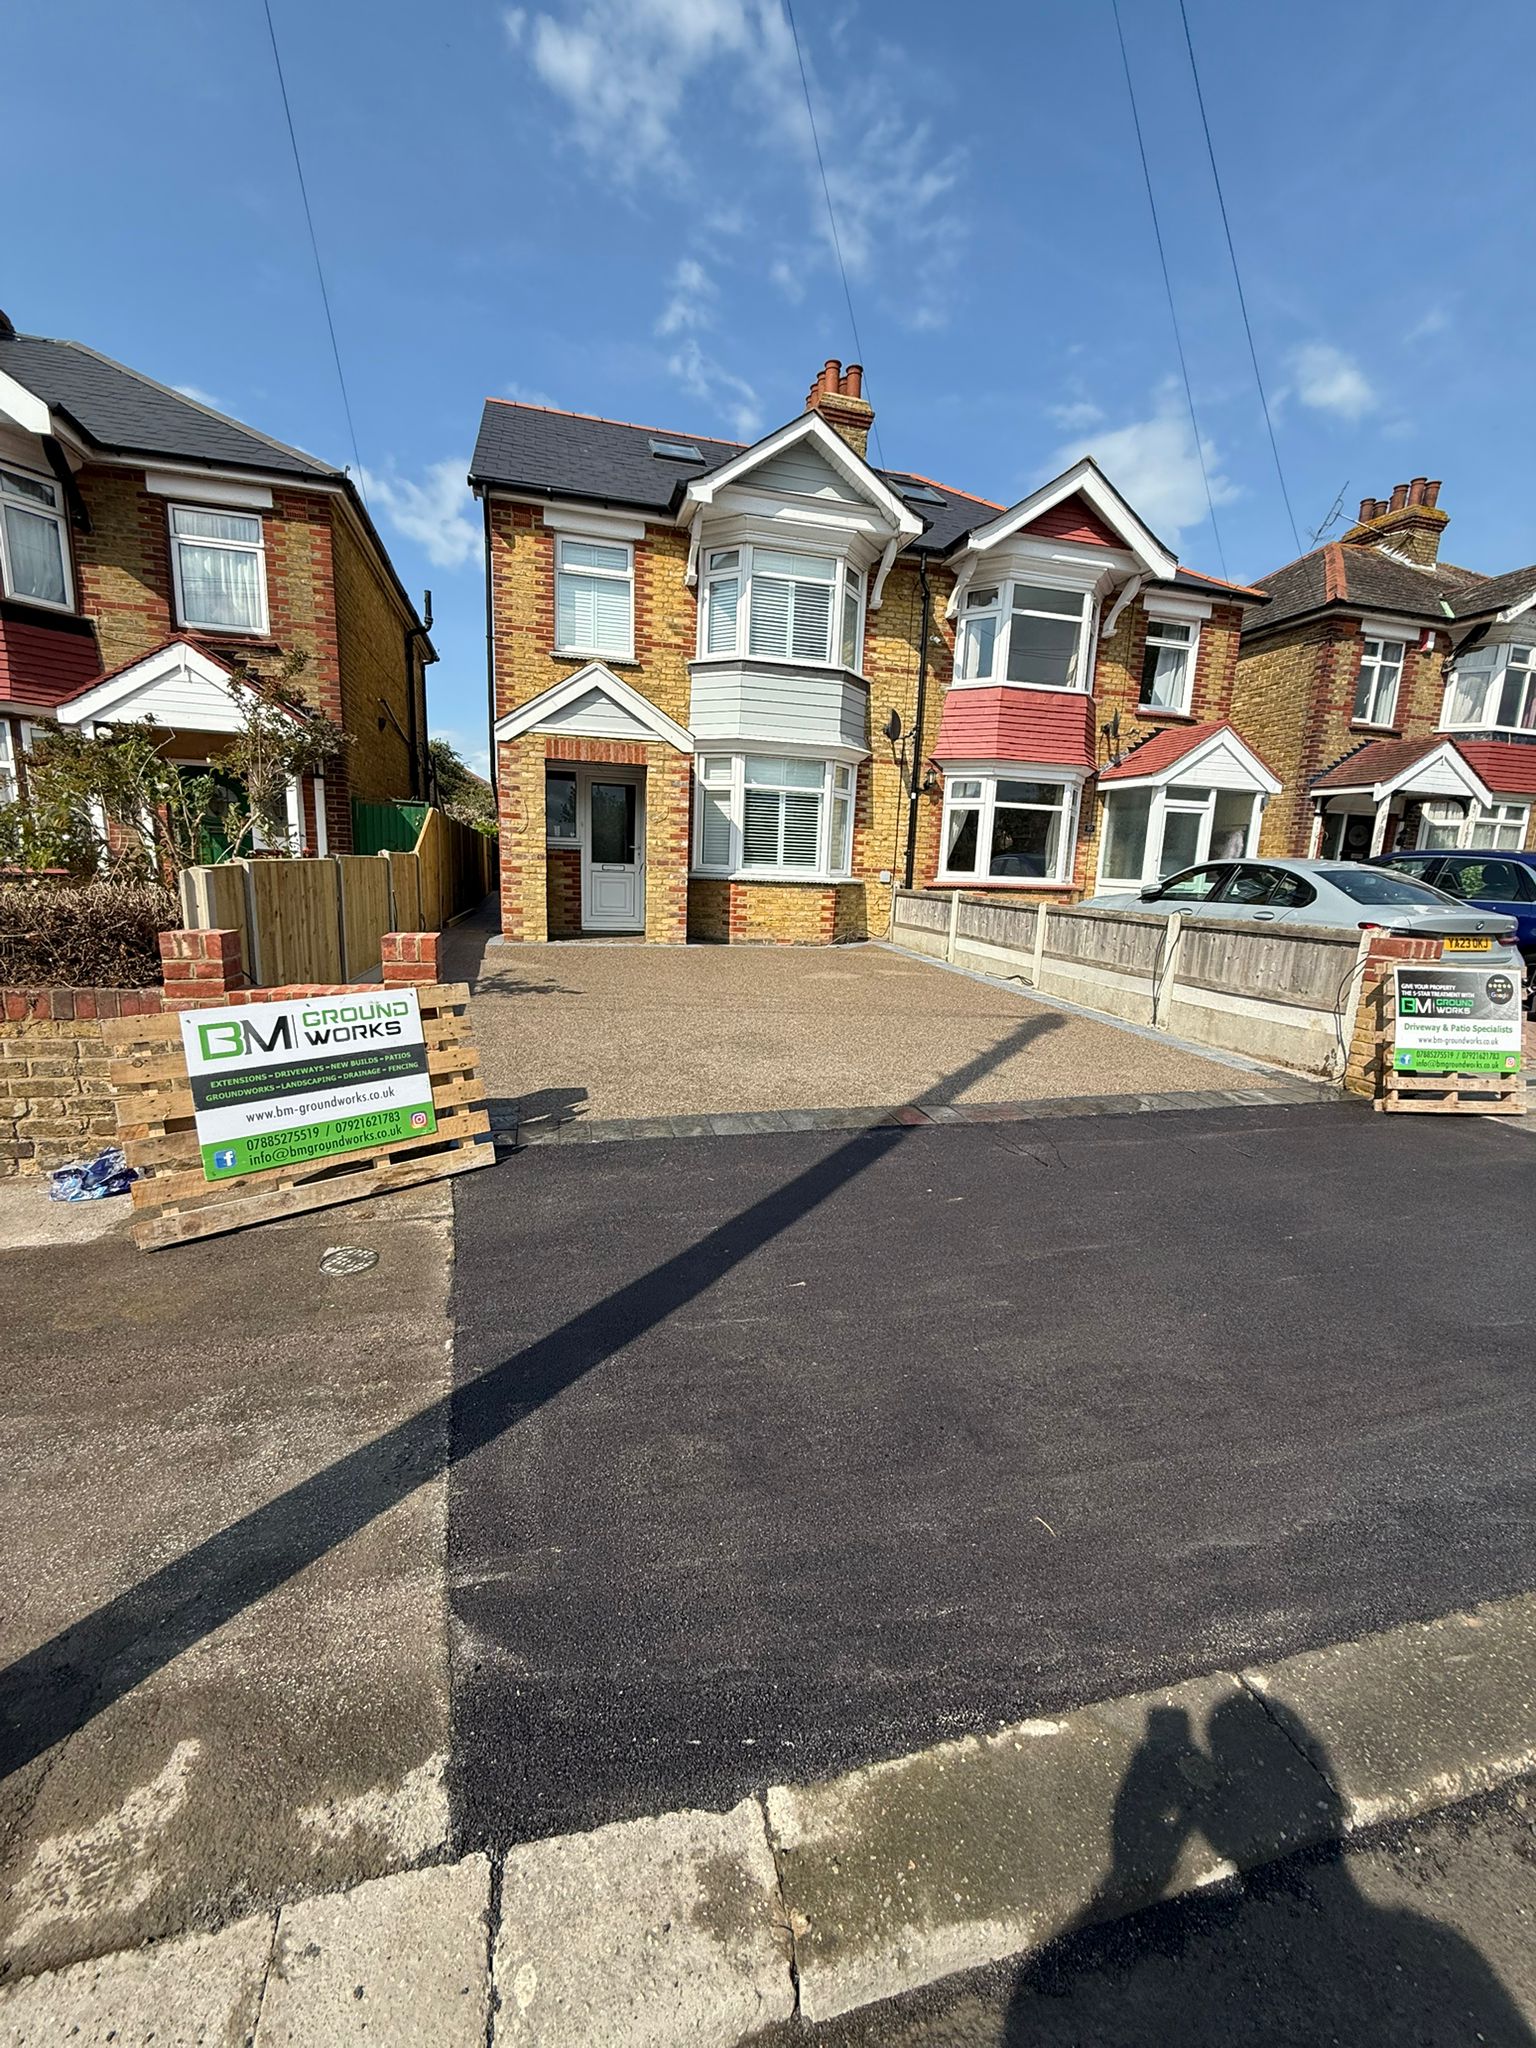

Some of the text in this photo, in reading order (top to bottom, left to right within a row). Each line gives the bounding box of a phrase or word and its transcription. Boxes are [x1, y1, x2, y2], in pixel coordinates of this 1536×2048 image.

[1448, 937, 1471, 948] YA23
[302, 1001, 409, 1027] GROUND
[1401, 998, 1432, 1014] BM
[1436, 998, 1474, 1007] GROUND
[1436, 1006, 1471, 1014] WORKS
[197, 1015, 293, 1061] BM
[304, 1020, 402, 1046] WORKS
[1404, 1023, 1440, 1032] Driveway
[1450, 1024, 1471, 1032] Patio
[1472, 1025, 1513, 1033] Specialists
[1418, 1036, 1499, 1045] www.bm-groundworks.co.uk
[205, 1084, 275, 1102] GROUNDWORKS
[281, 1074, 337, 1090] LANDSCAPING
[342, 1067, 381, 1080] DRAINAGE
[387, 1061, 419, 1073] FENCING
[210, 1073, 267, 1088] EXTENSIONS
[274, 1065, 325, 1078] DRIVEWAYS
[330, 1061, 349, 1070] NEW
[350, 1056, 379, 1067] BUILDS
[384, 1051, 411, 1061] PATIOS
[246, 1086, 395, 1122] www.bm-groundworks.co.uk
[246, 1111, 401, 1151] 07885275519 / 07921621783
[249, 1125, 403, 1167] info@bmgroundworks.co.uk
